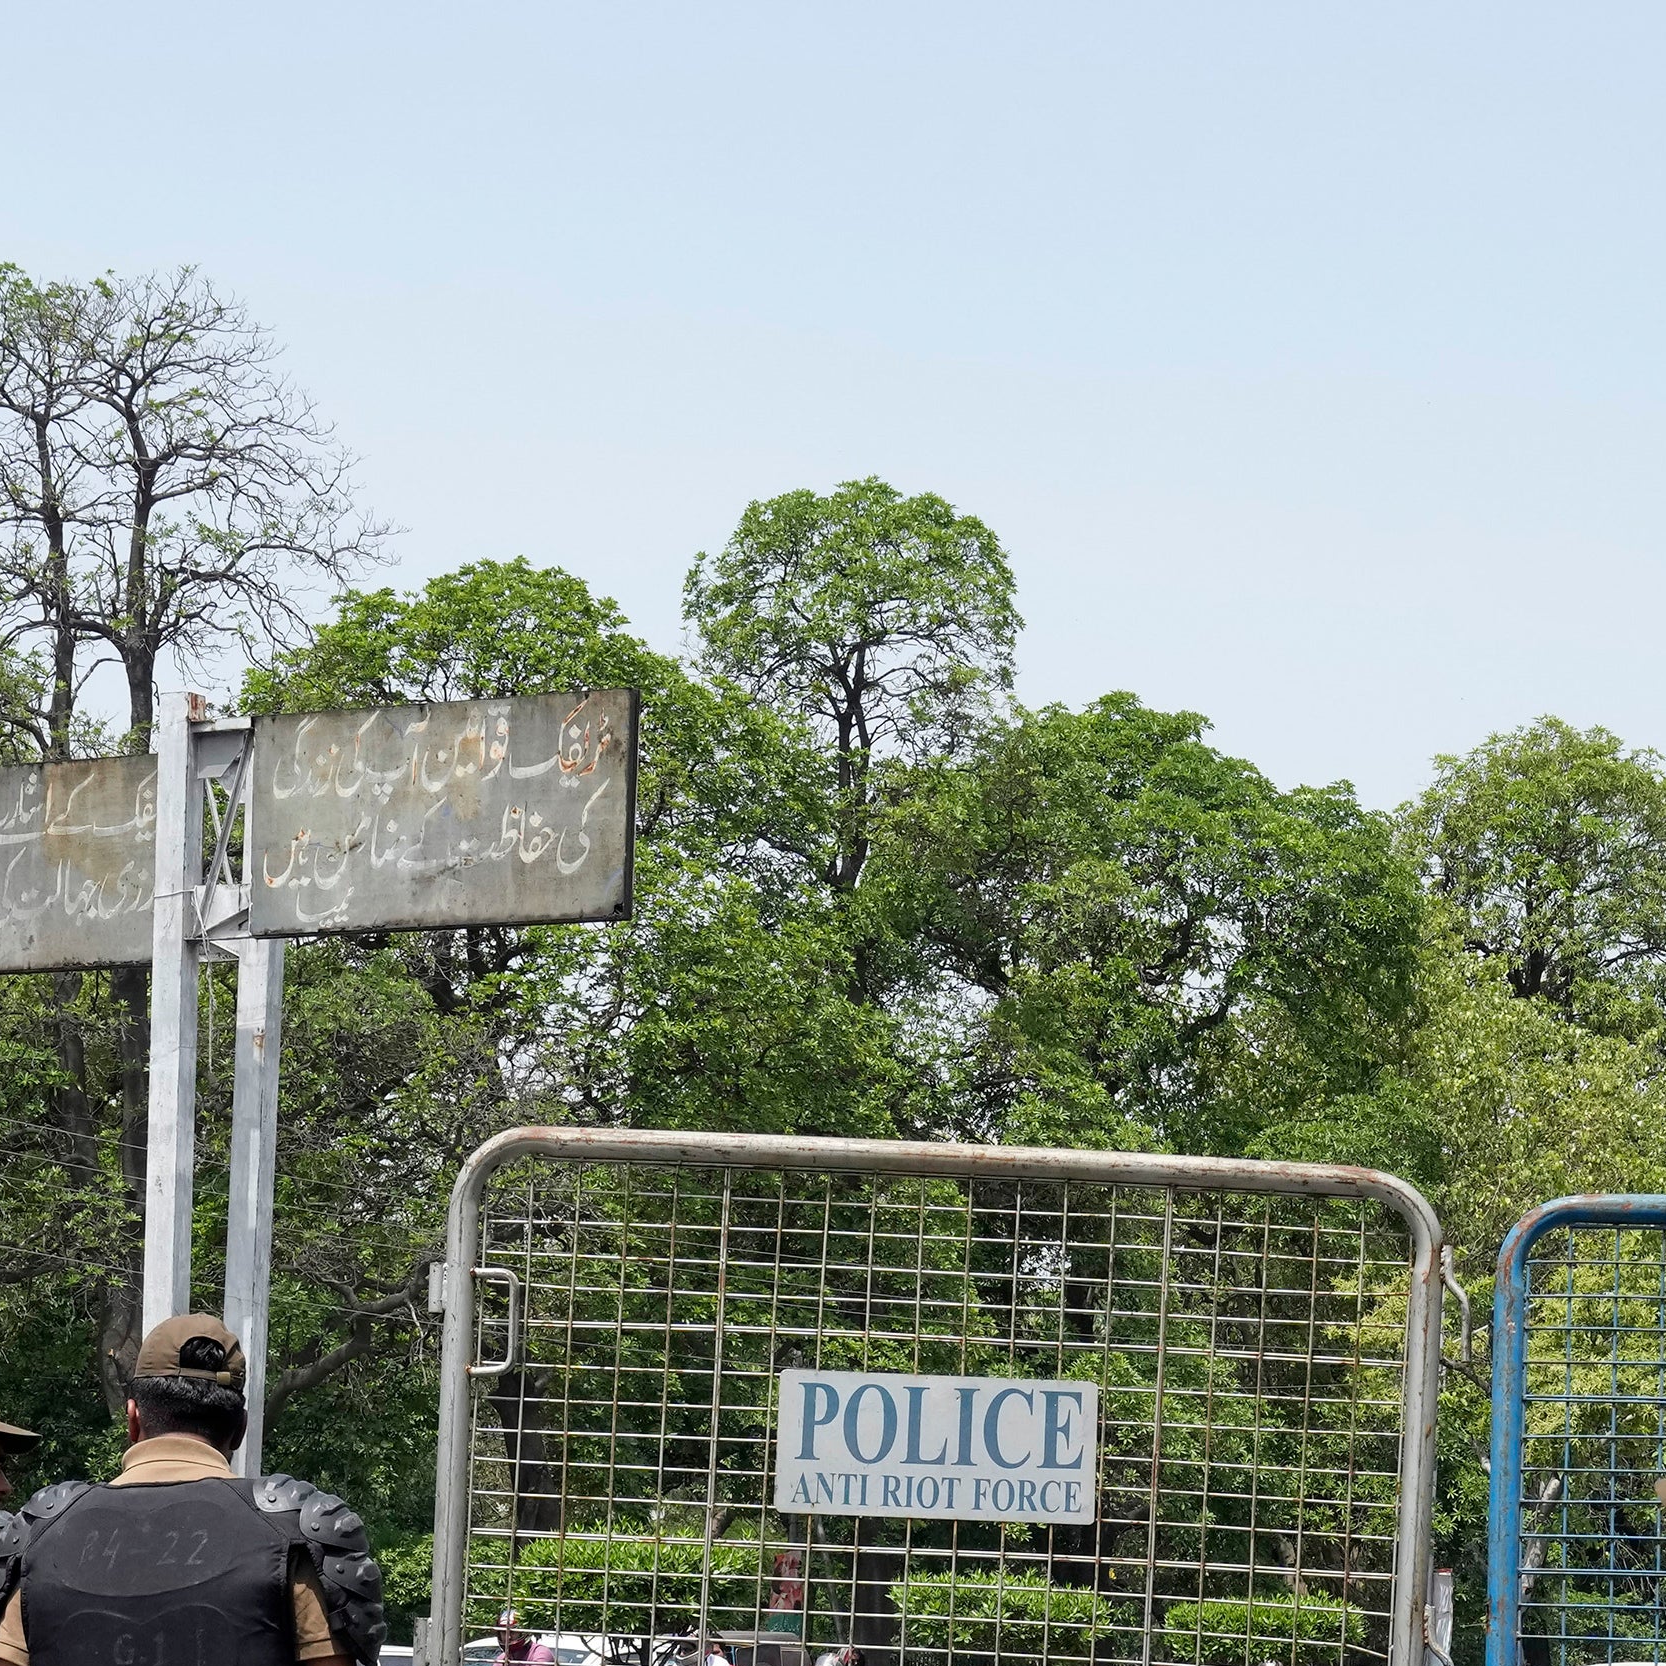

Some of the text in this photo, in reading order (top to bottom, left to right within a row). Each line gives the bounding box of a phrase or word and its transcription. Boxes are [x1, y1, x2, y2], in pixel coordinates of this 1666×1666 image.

[795, 1381, 1084, 1470] POLICE
[791, 1471, 1082, 1514] ANTI RIOT FORCE
